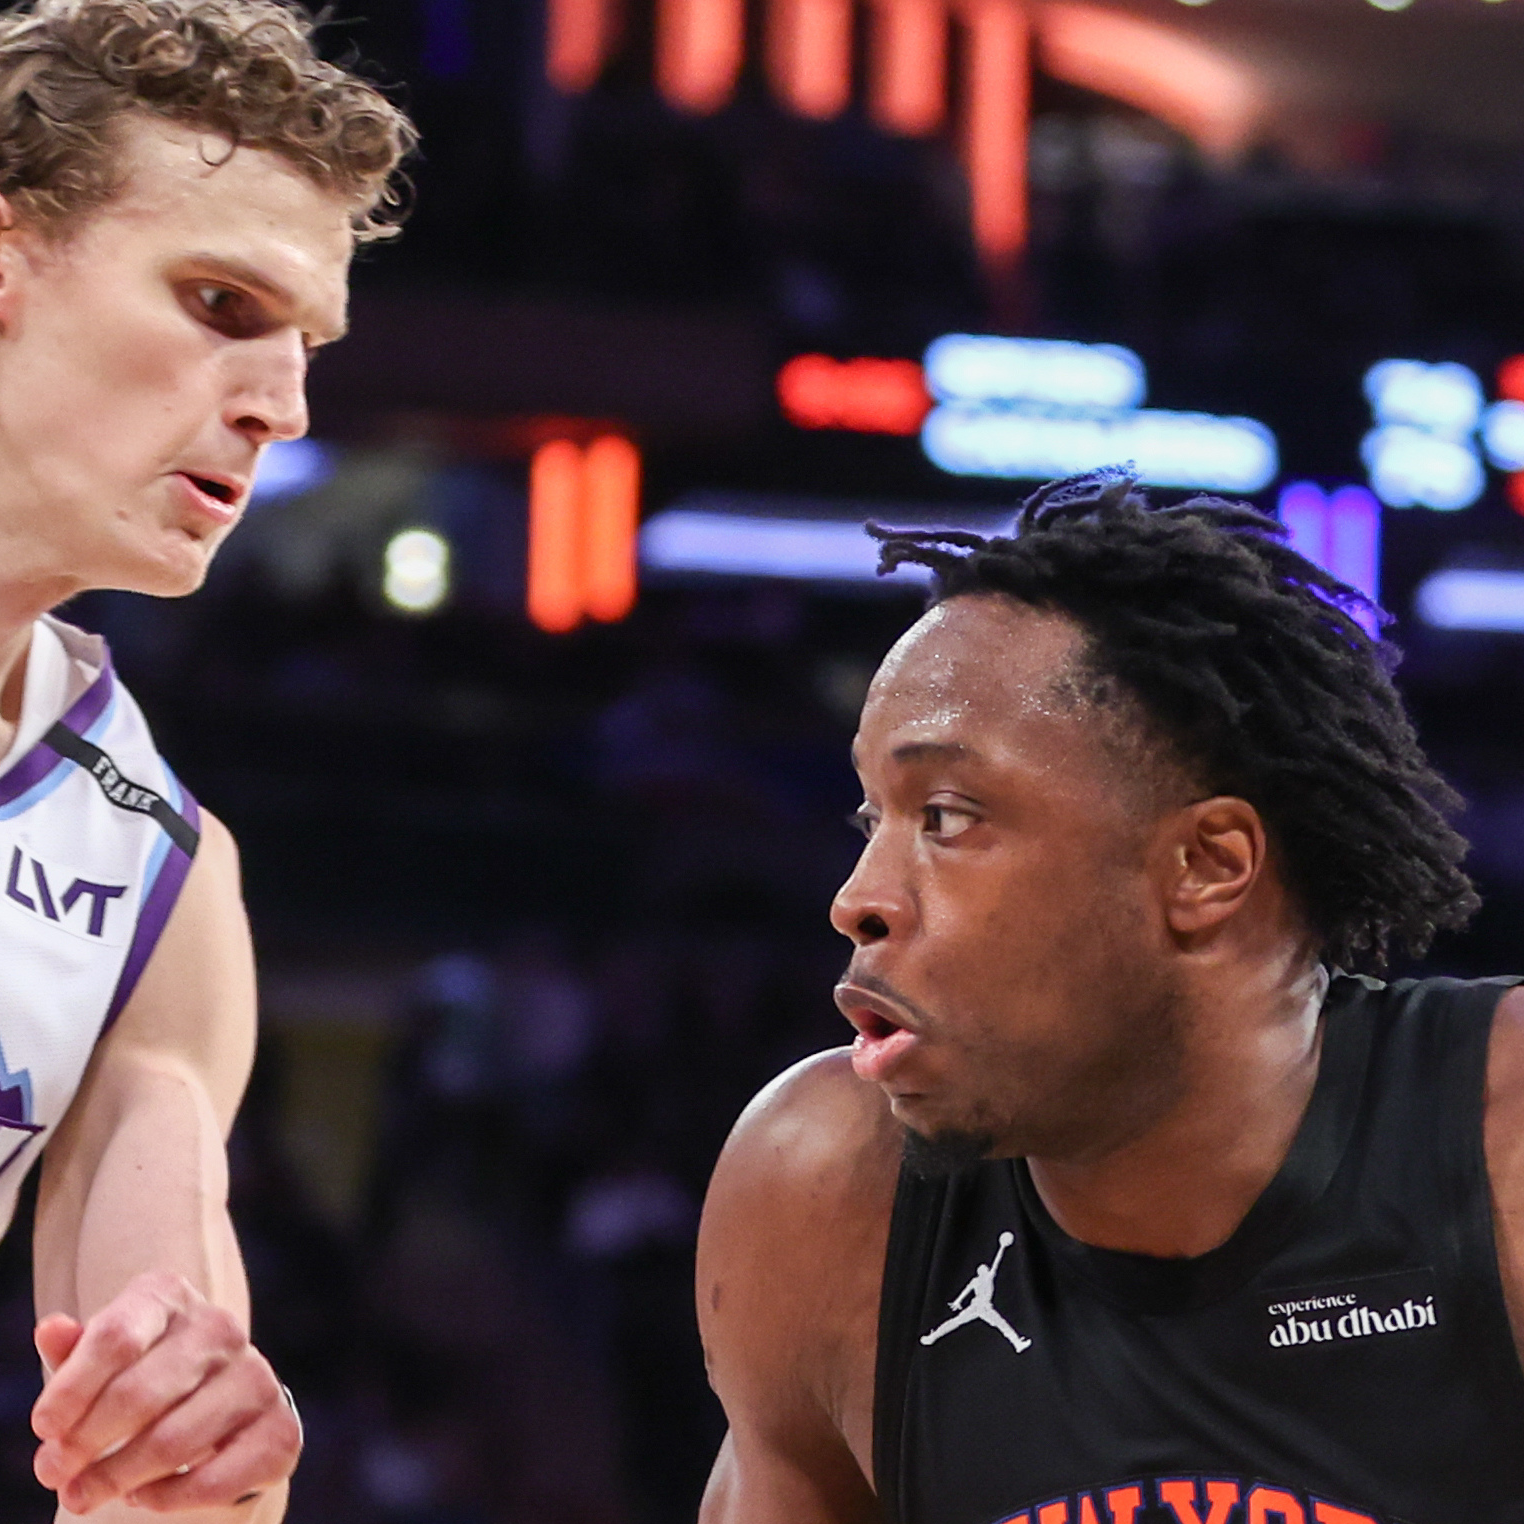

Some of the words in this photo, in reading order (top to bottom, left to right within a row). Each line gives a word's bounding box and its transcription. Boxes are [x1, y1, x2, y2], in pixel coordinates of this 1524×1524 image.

[92, 755, 160, 811] FRANK
[5, 846, 128, 938] LVT
[1268, 1293, 1357, 1316] experience
[1269, 1316, 1333, 1348] abu
[1337, 1296, 1437, 1338] dhabi
